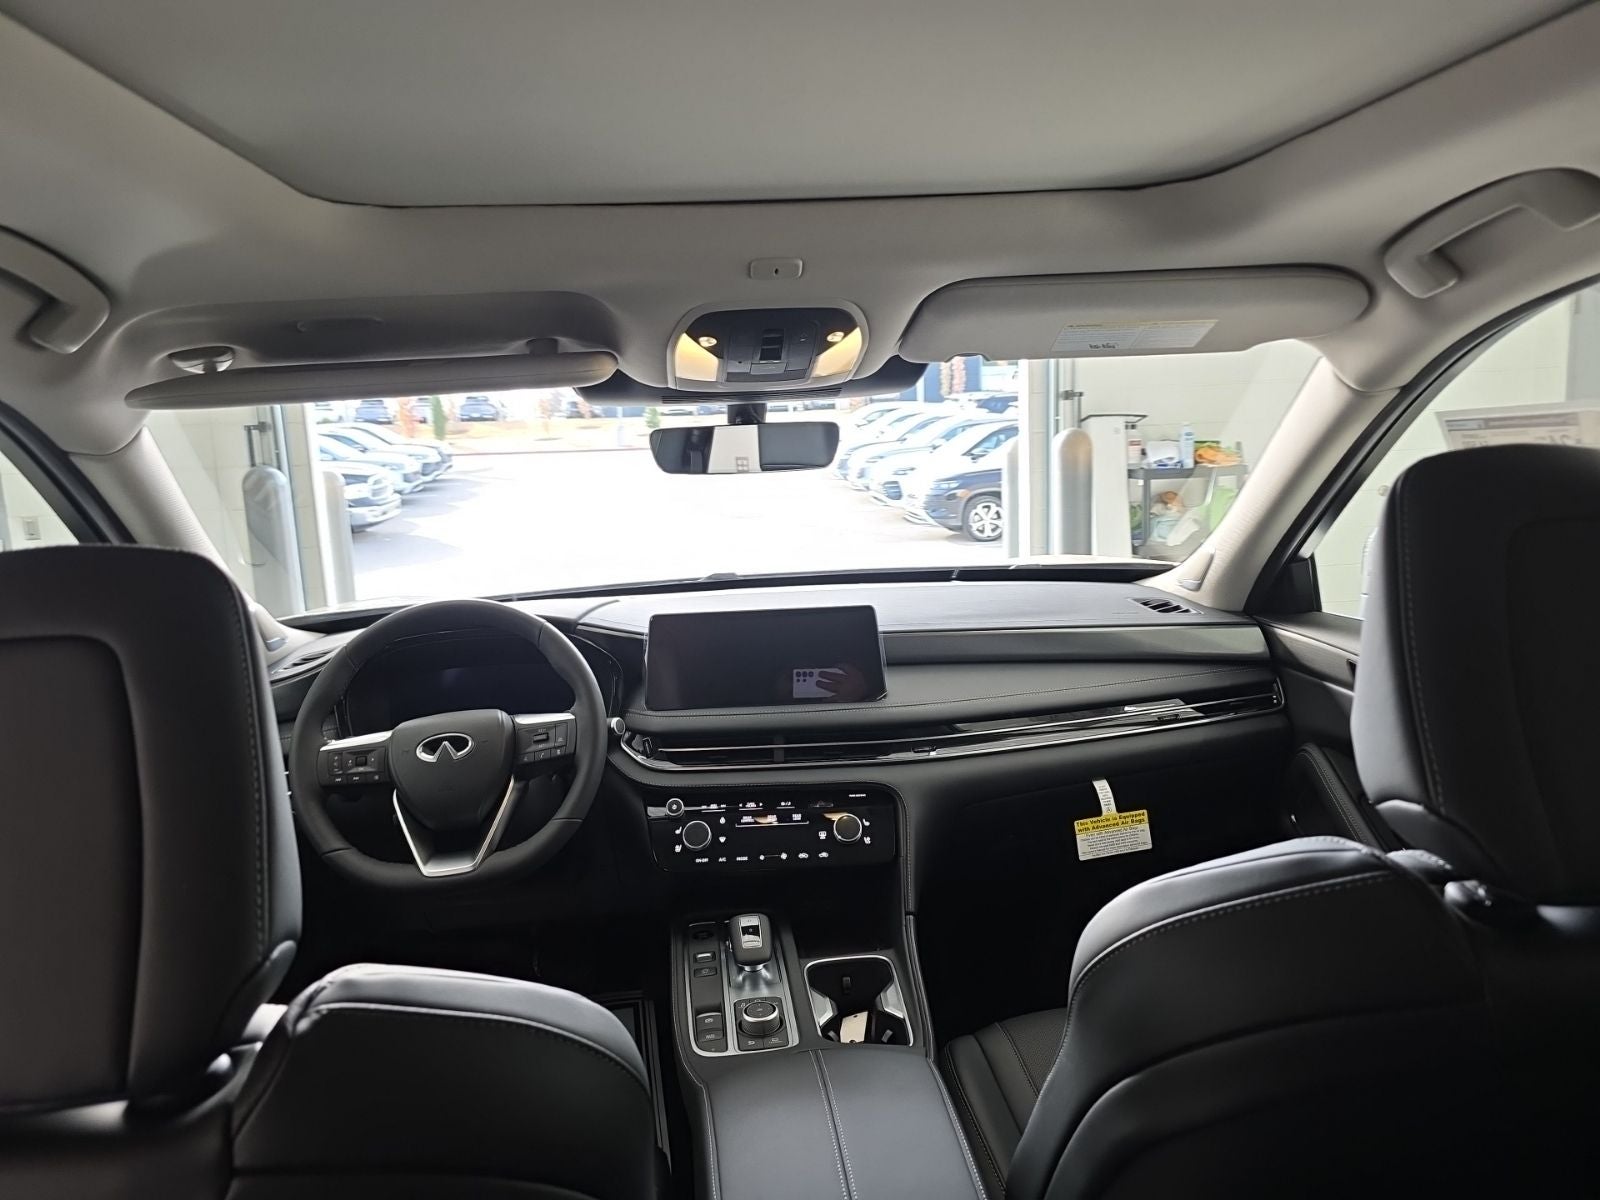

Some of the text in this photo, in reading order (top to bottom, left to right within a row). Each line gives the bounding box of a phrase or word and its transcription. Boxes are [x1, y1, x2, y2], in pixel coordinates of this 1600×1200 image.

[1118, 812, 1145, 820] Equipped
[1091, 822, 1120, 831] Advanced
[1130, 817, 1145, 825] Bags
